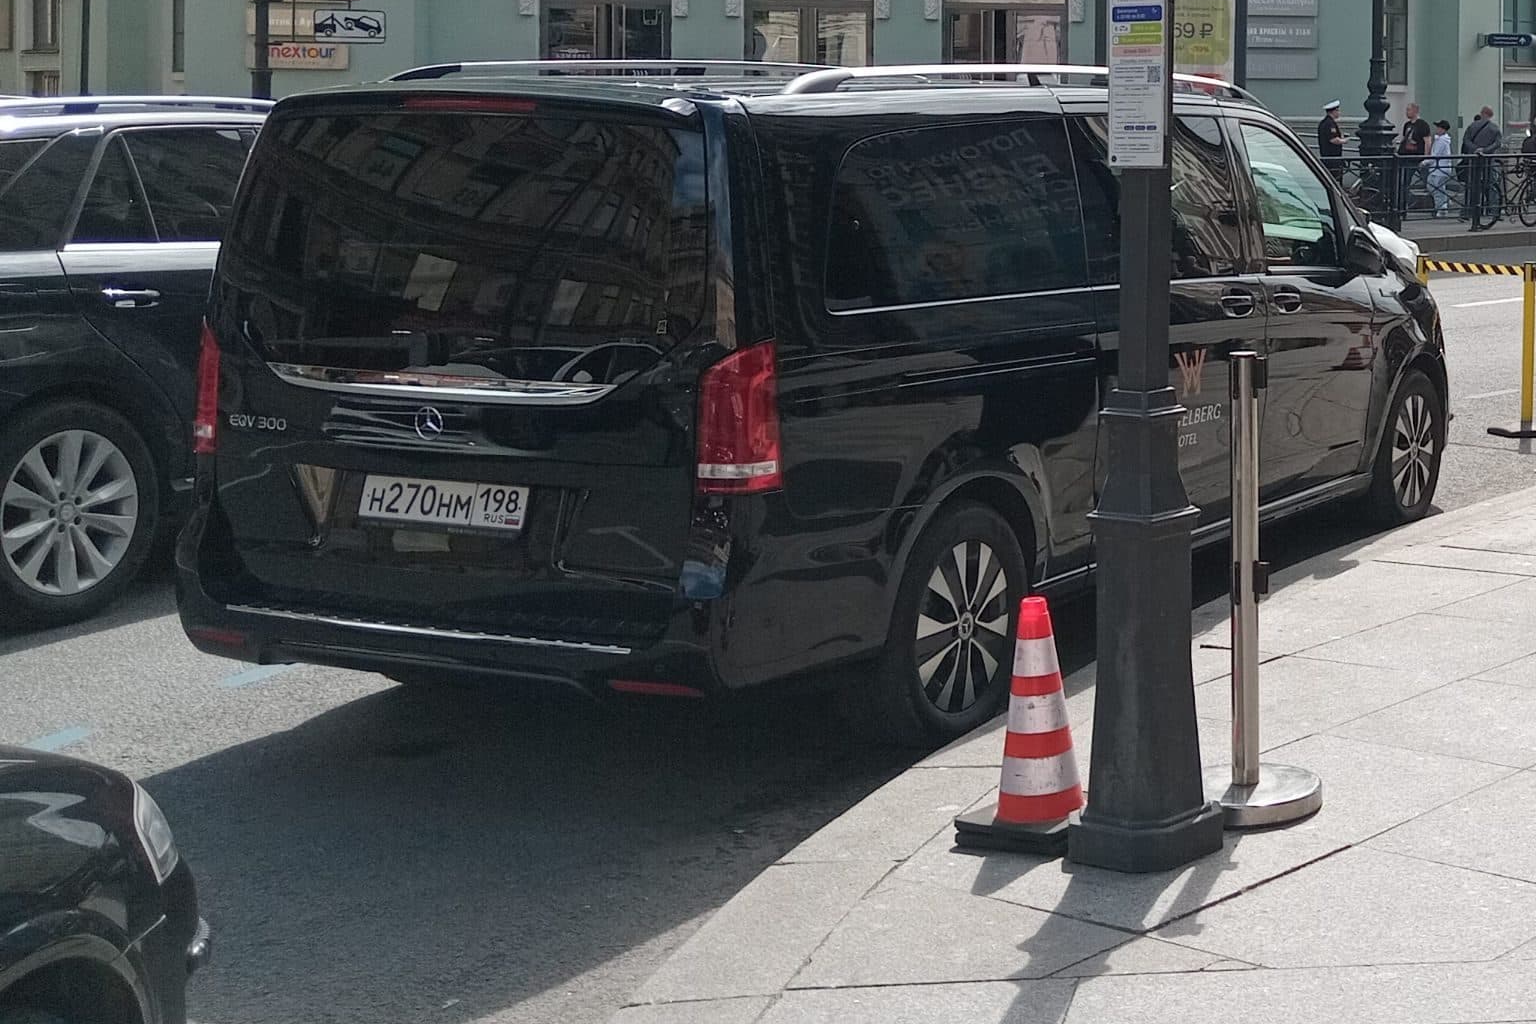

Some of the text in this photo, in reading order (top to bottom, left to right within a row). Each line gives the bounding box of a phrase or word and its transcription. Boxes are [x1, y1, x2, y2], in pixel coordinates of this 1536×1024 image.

[270, 46, 335, 59] nextour
[229, 414, 287, 431] EQV 300
[1177, 403, 1222, 427] ELBERG
[1178, 433, 1198, 447] OTEL
[479, 487, 520, 514] 198
[483, 513, 505, 524] RUS
